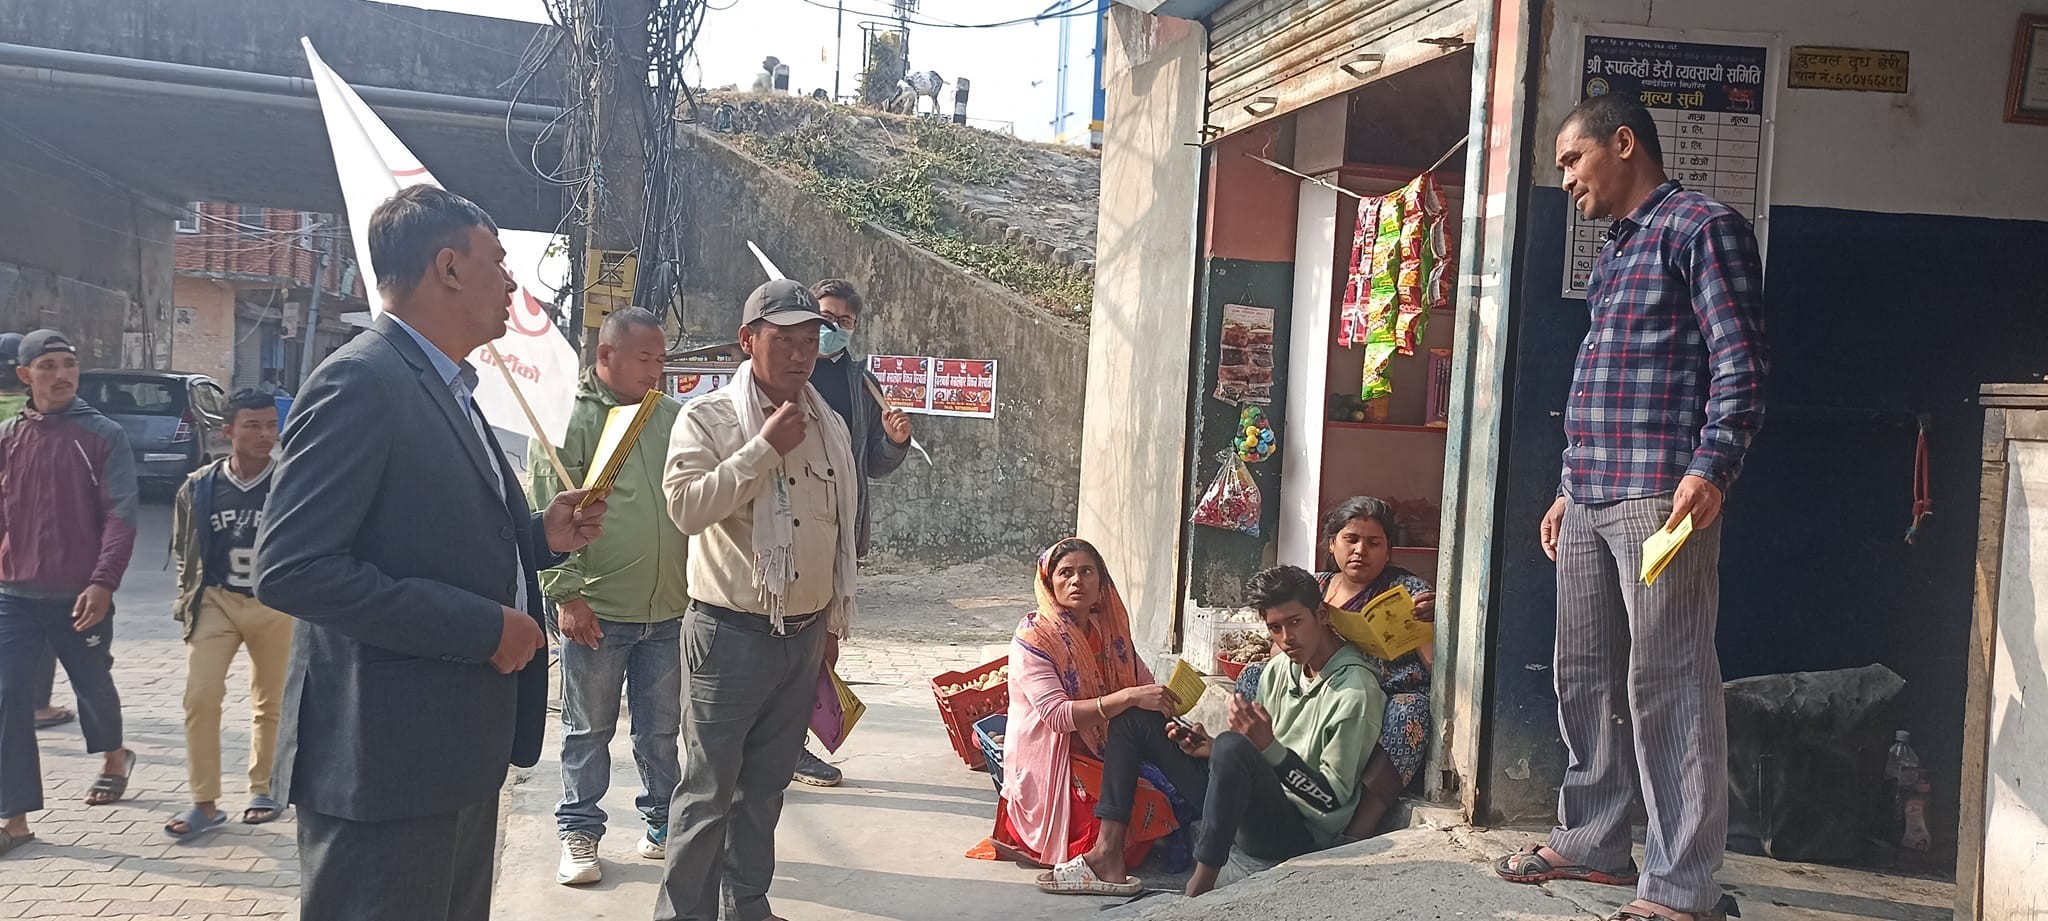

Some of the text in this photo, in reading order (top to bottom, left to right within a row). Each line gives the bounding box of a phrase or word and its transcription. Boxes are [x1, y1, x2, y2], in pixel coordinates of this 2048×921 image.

[1587, 55, 1601, 74] श्री
[1652, 59, 1673, 79] डेरी
[1676, 64, 1723, 82] व्यवसायी
[1726, 65, 1762, 85] समिति
[210, 509, 264, 533] SPUR
